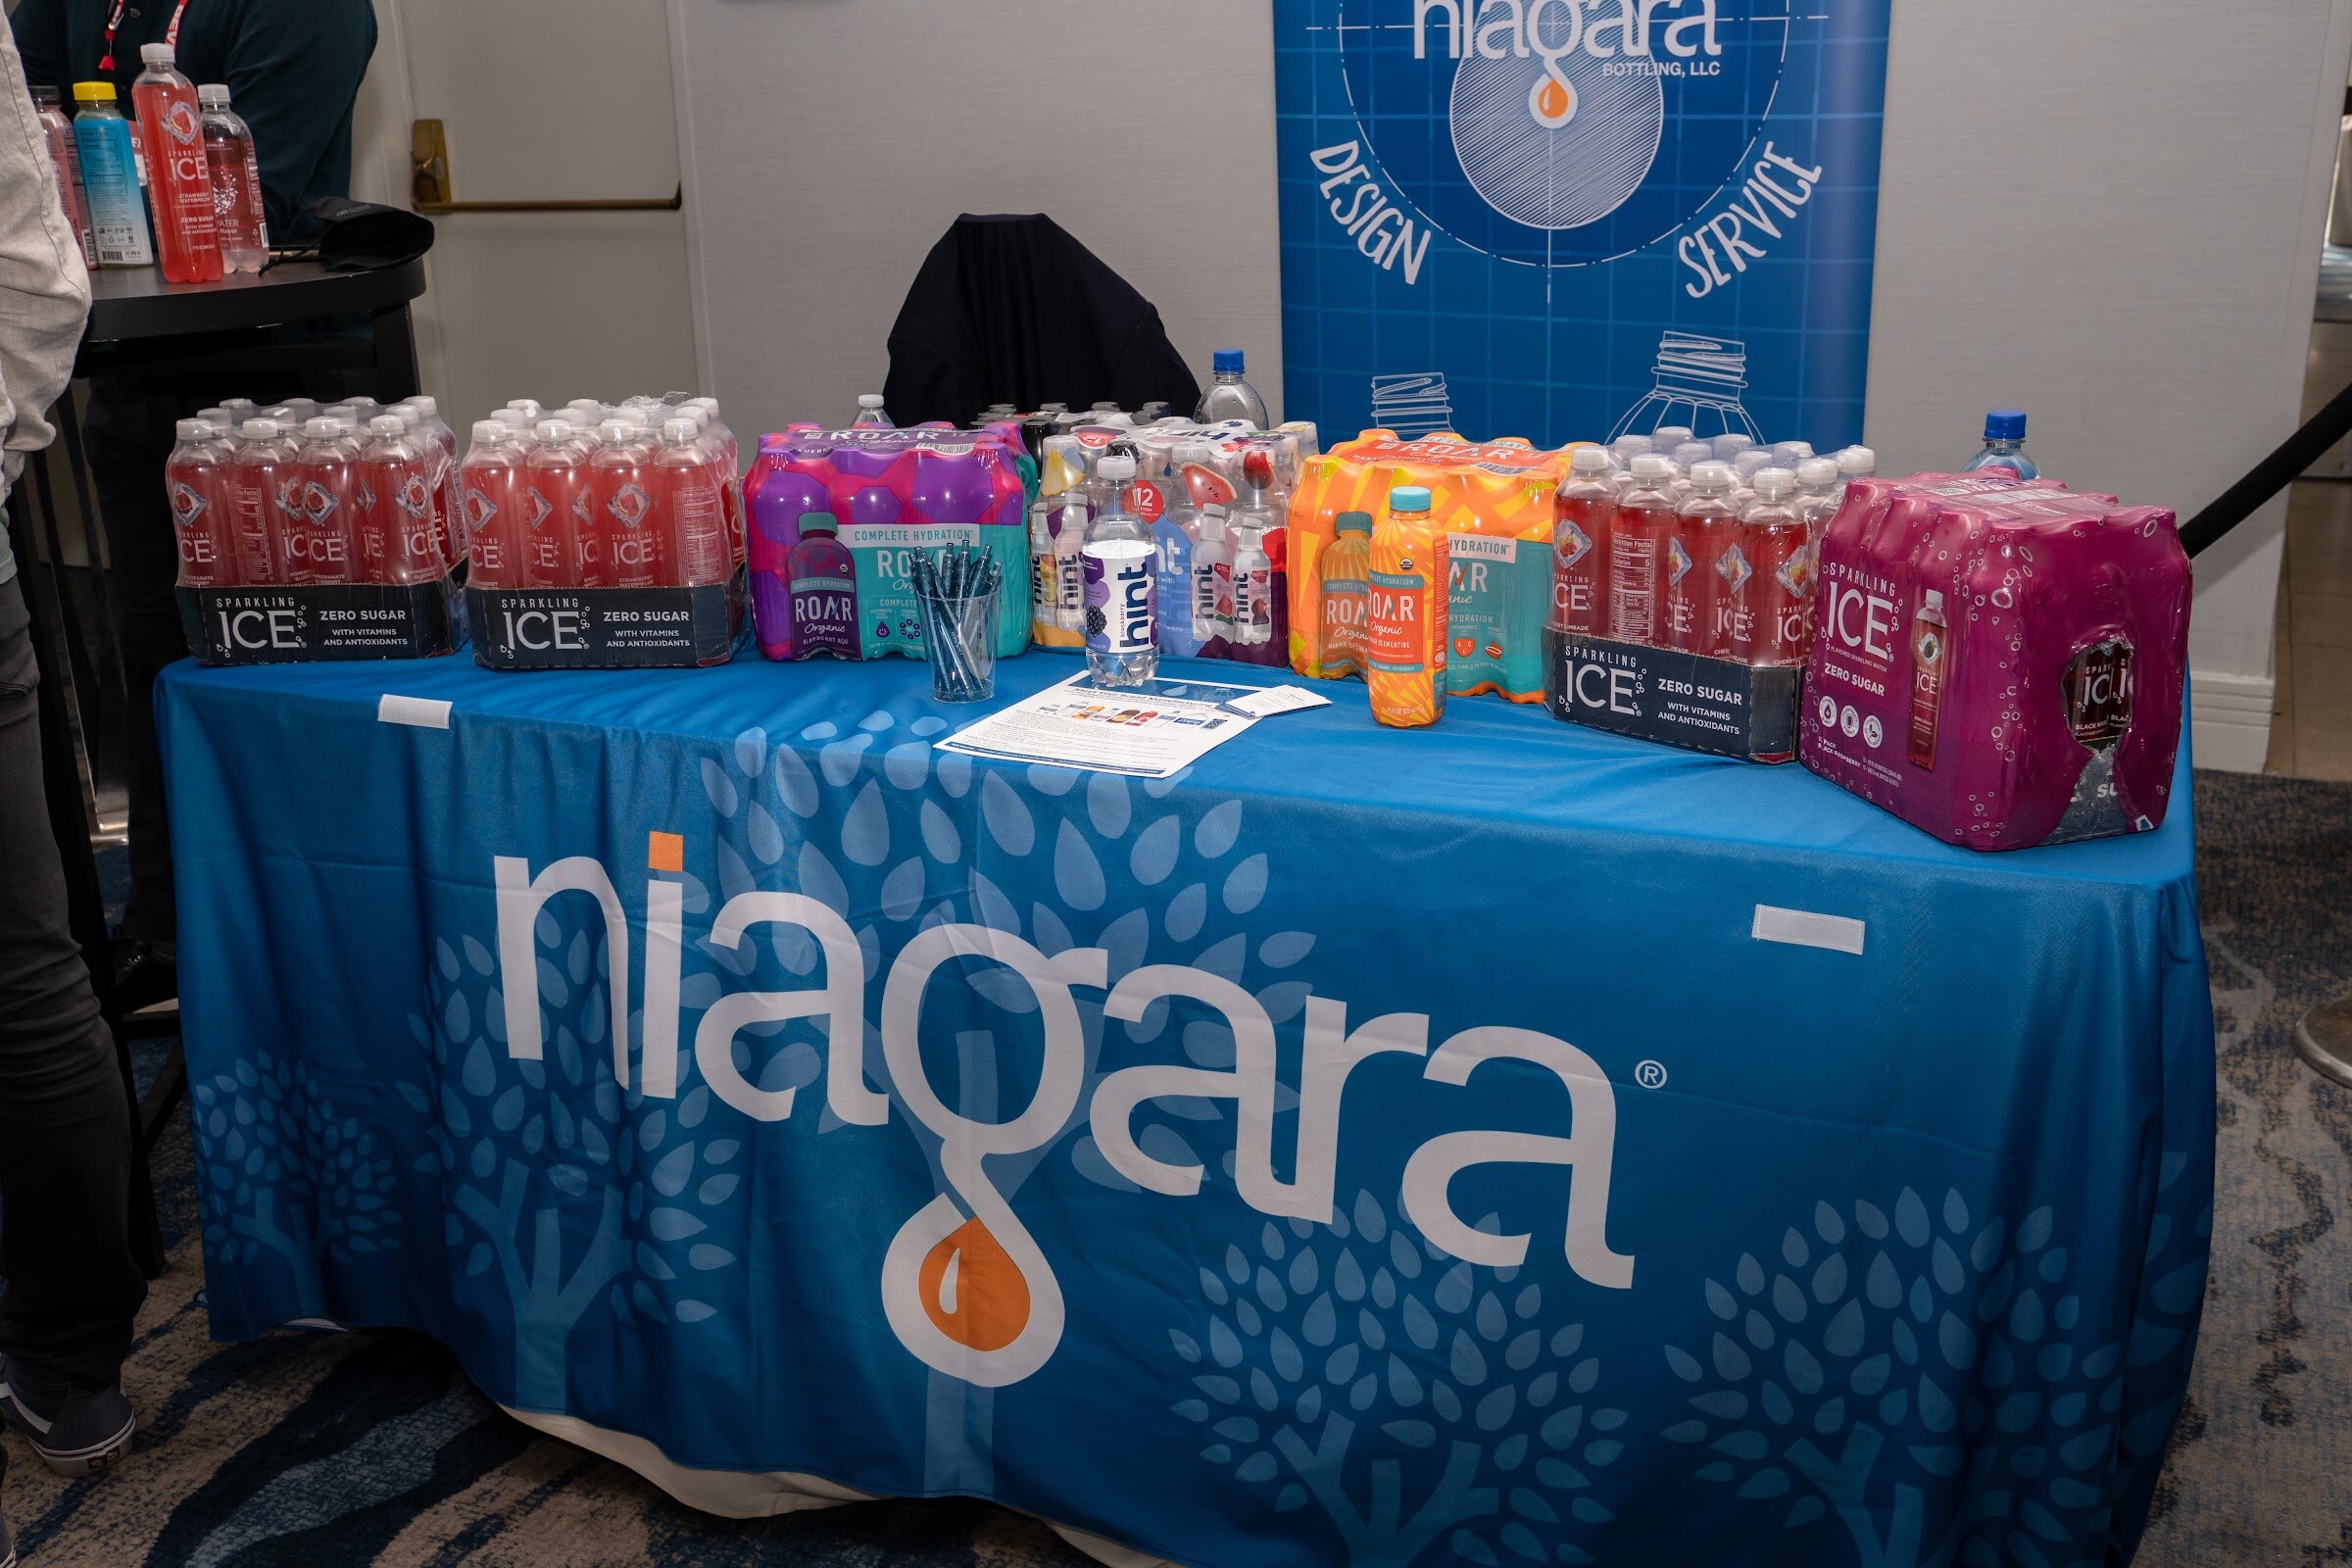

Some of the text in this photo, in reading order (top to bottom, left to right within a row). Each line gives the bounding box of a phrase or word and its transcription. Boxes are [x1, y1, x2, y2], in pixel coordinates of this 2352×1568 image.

[1602, 61, 1720, 78] BOTTLING, LLC
[170, 157, 210, 181] ICE
[1309, 140, 1432, 285] DESIGN
[1678, 141, 1822, 298] SERVICE
[1399, 443, 1515, 459] ROAR
[855, 530, 908, 541] COMPLETE
[180, 539, 213, 563] CE
[310, 538, 344, 562] CE
[470, 544, 501, 568] CE
[613, 539, 655, 565] ICE
[1059, 554, 1078, 609] hint
[1449, 561, 1488, 592] AR
[1829, 562, 1895, 597] SPARKLING
[217, 597, 295, 608] SPARKLING
[502, 598, 579, 608] SPARKLING
[1195, 564, 1214, 619] hint
[1234, 573, 1249, 623] hint
[1555, 583, 1588, 610] CE
[319, 610, 406, 621] ZERO SUGAR
[795, 596, 853, 622] ROAR
[1117, 562, 1149, 647] hint
[1327, 599, 1368, 627] ROA
[603, 612, 689, 622] ZERO SUGAR
[805, 623, 846, 634] Organic
[1371, 621, 1402, 636] Organic
[1828, 581, 1893, 660] ICE
[218, 610, 300, 649] ICE
[503, 611, 583, 650] ICE
[803, 636, 836, 645] BLUEBERRY
[1335, 627, 1368, 640] Organi
[1378, 639, 1410, 648] CLEMENTINE
[1565, 645, 1636, 668] SPARKLING
[1831, 646, 1887, 673] FLAVORED SPARKLING WATER
[1566, 660, 1636, 715] ICE
[1824, 663, 1885, 696] ZERO SUGAR
[1916, 672, 1938, 695] ICE
[1658, 678, 1742, 706] ZERO SUGAR
[1667, 701, 1730, 721] WITH VITAMINS
[1658, 712, 1740, 735] AND ANTIOXIDANTS
[1823, 739, 1836, 749] PACK
[1834, 750, 1861, 767] RASPBERRY
[493, 830, 1636, 1387] niagara
